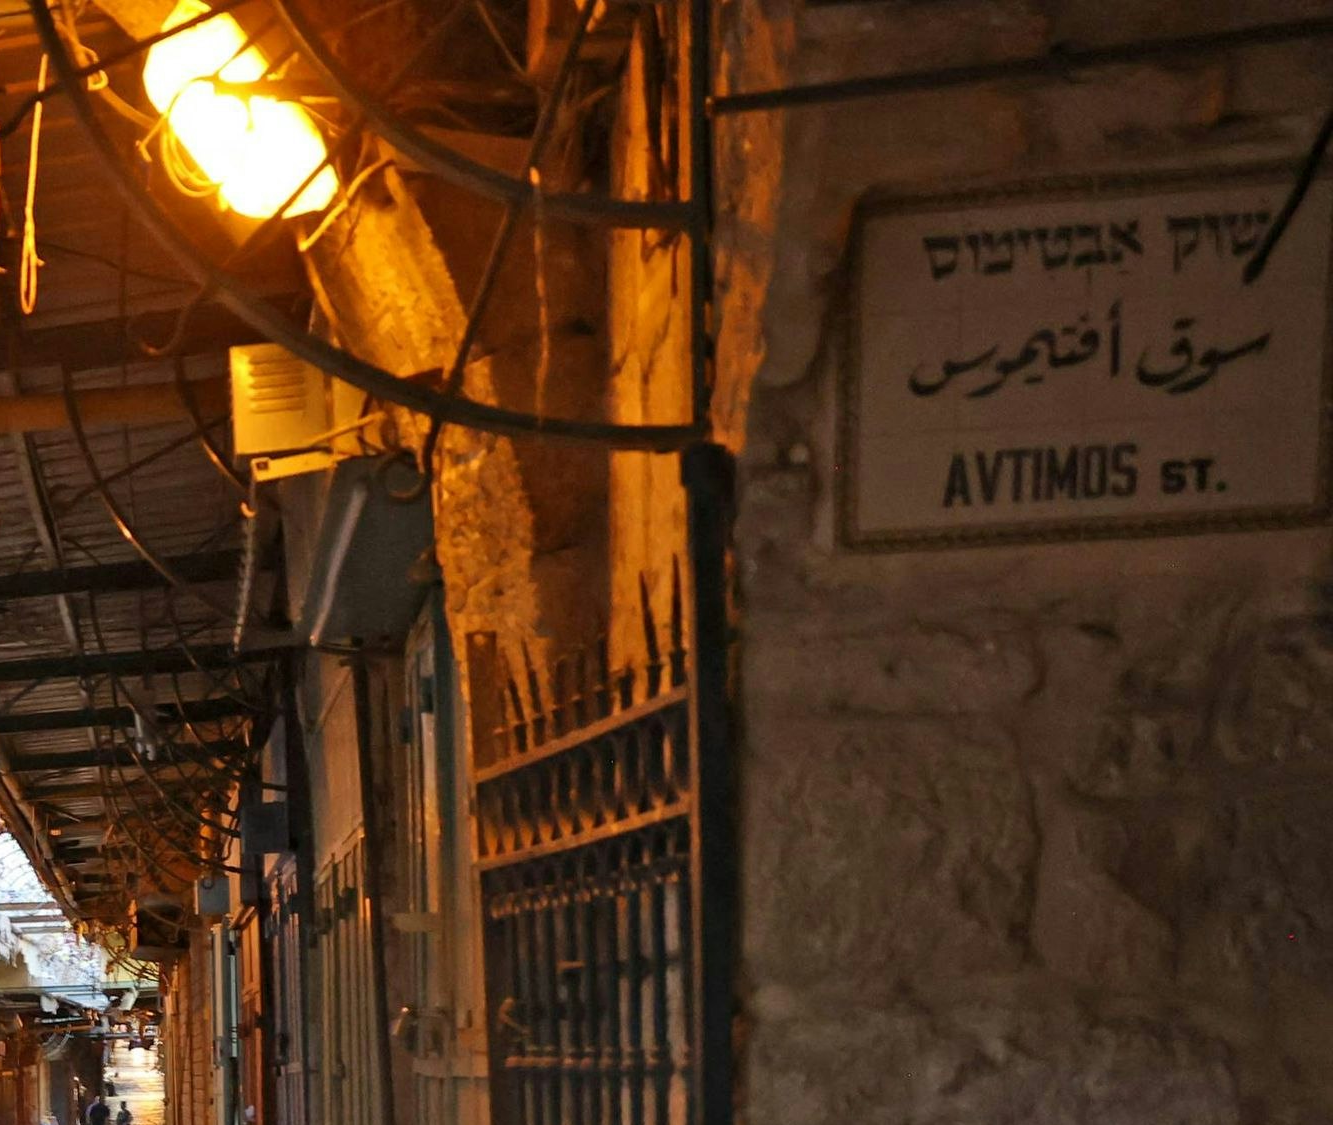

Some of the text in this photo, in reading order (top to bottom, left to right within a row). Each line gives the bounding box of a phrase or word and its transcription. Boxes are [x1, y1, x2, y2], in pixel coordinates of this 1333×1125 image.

[923, 212, 1271, 281] שוק אבטימוס
[1136, 315, 1271, 395] سوق
[942, 443, 1228, 508] AVTIMOS ST.
